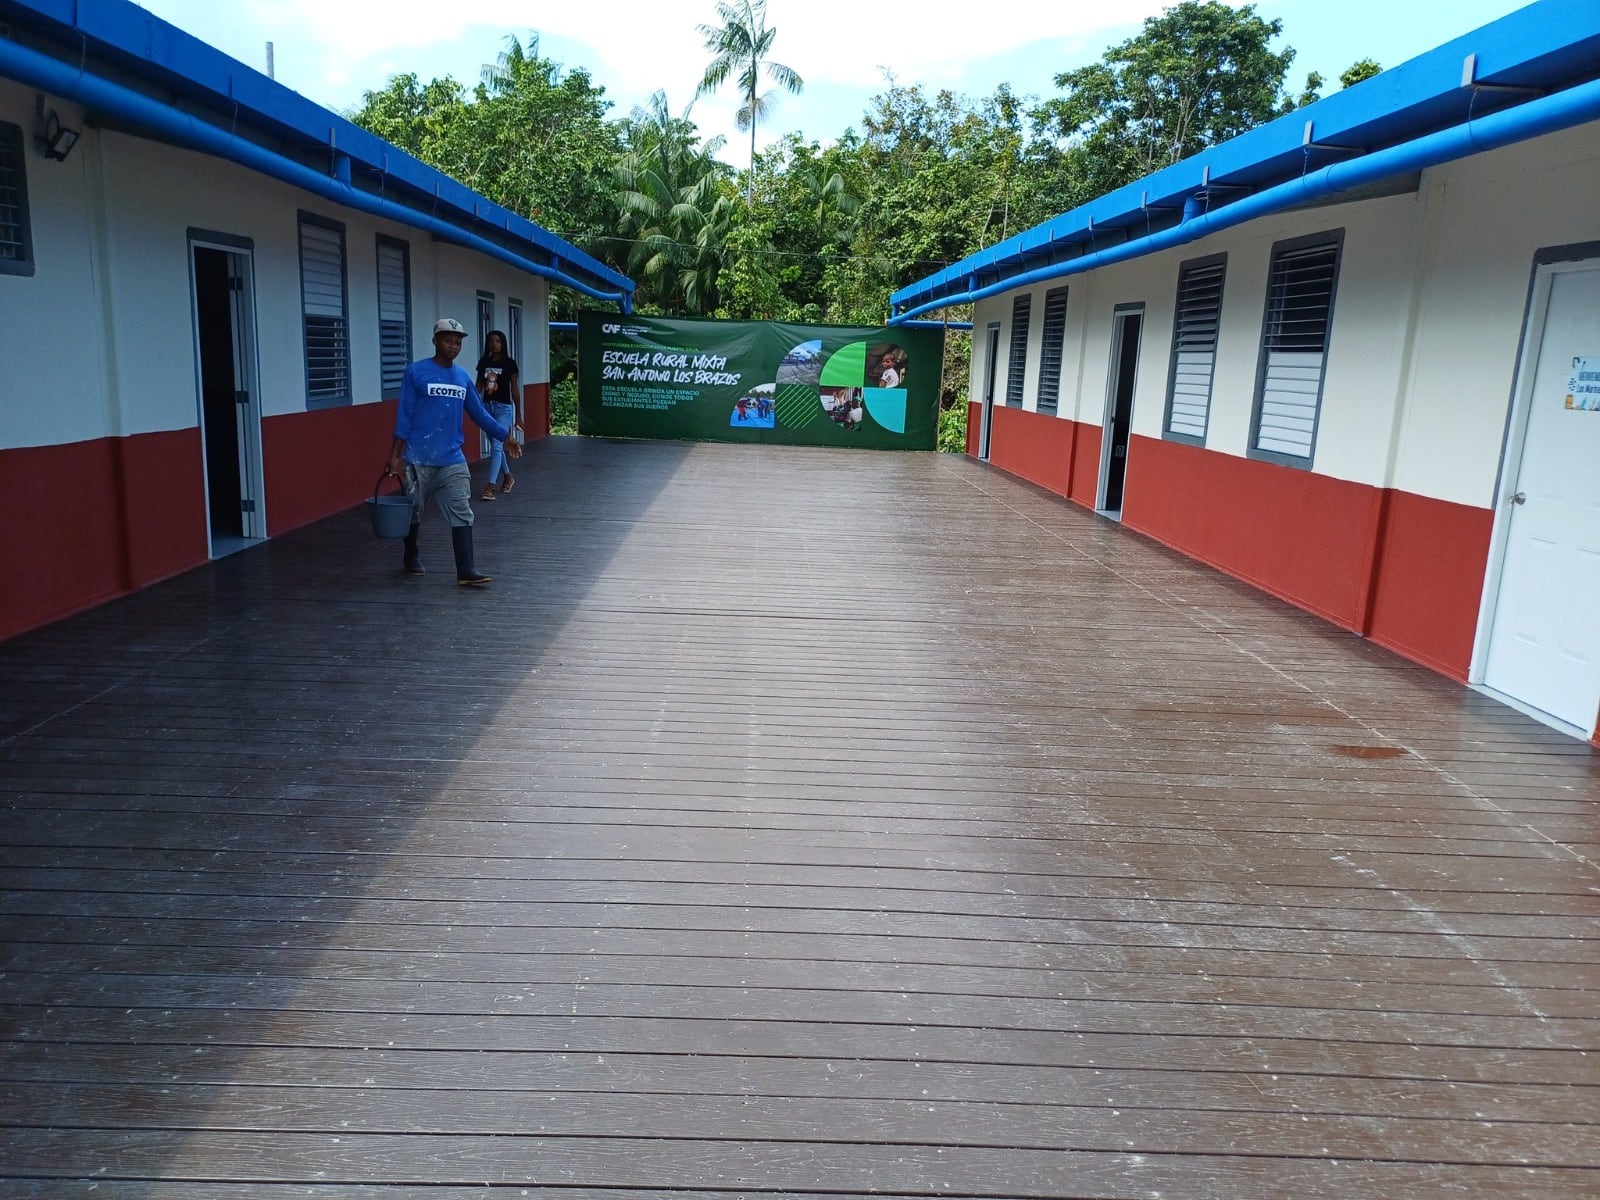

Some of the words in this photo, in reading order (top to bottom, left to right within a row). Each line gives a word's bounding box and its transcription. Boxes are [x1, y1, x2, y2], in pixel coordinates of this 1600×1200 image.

[602, 323, 621, 334] CAF
[602, 351, 649, 366] ESCUELA
[652, 353, 689, 369] RURAL
[691, 354, 727, 370] MIXTA
[602, 365, 625, 380] SAN
[627, 367, 670, 382] ANTONIO
[673, 369, 693, 383] LOS
[694, 370, 741, 386] BRAZOS
[613, 396, 652, 404] ESTUDIANTES
